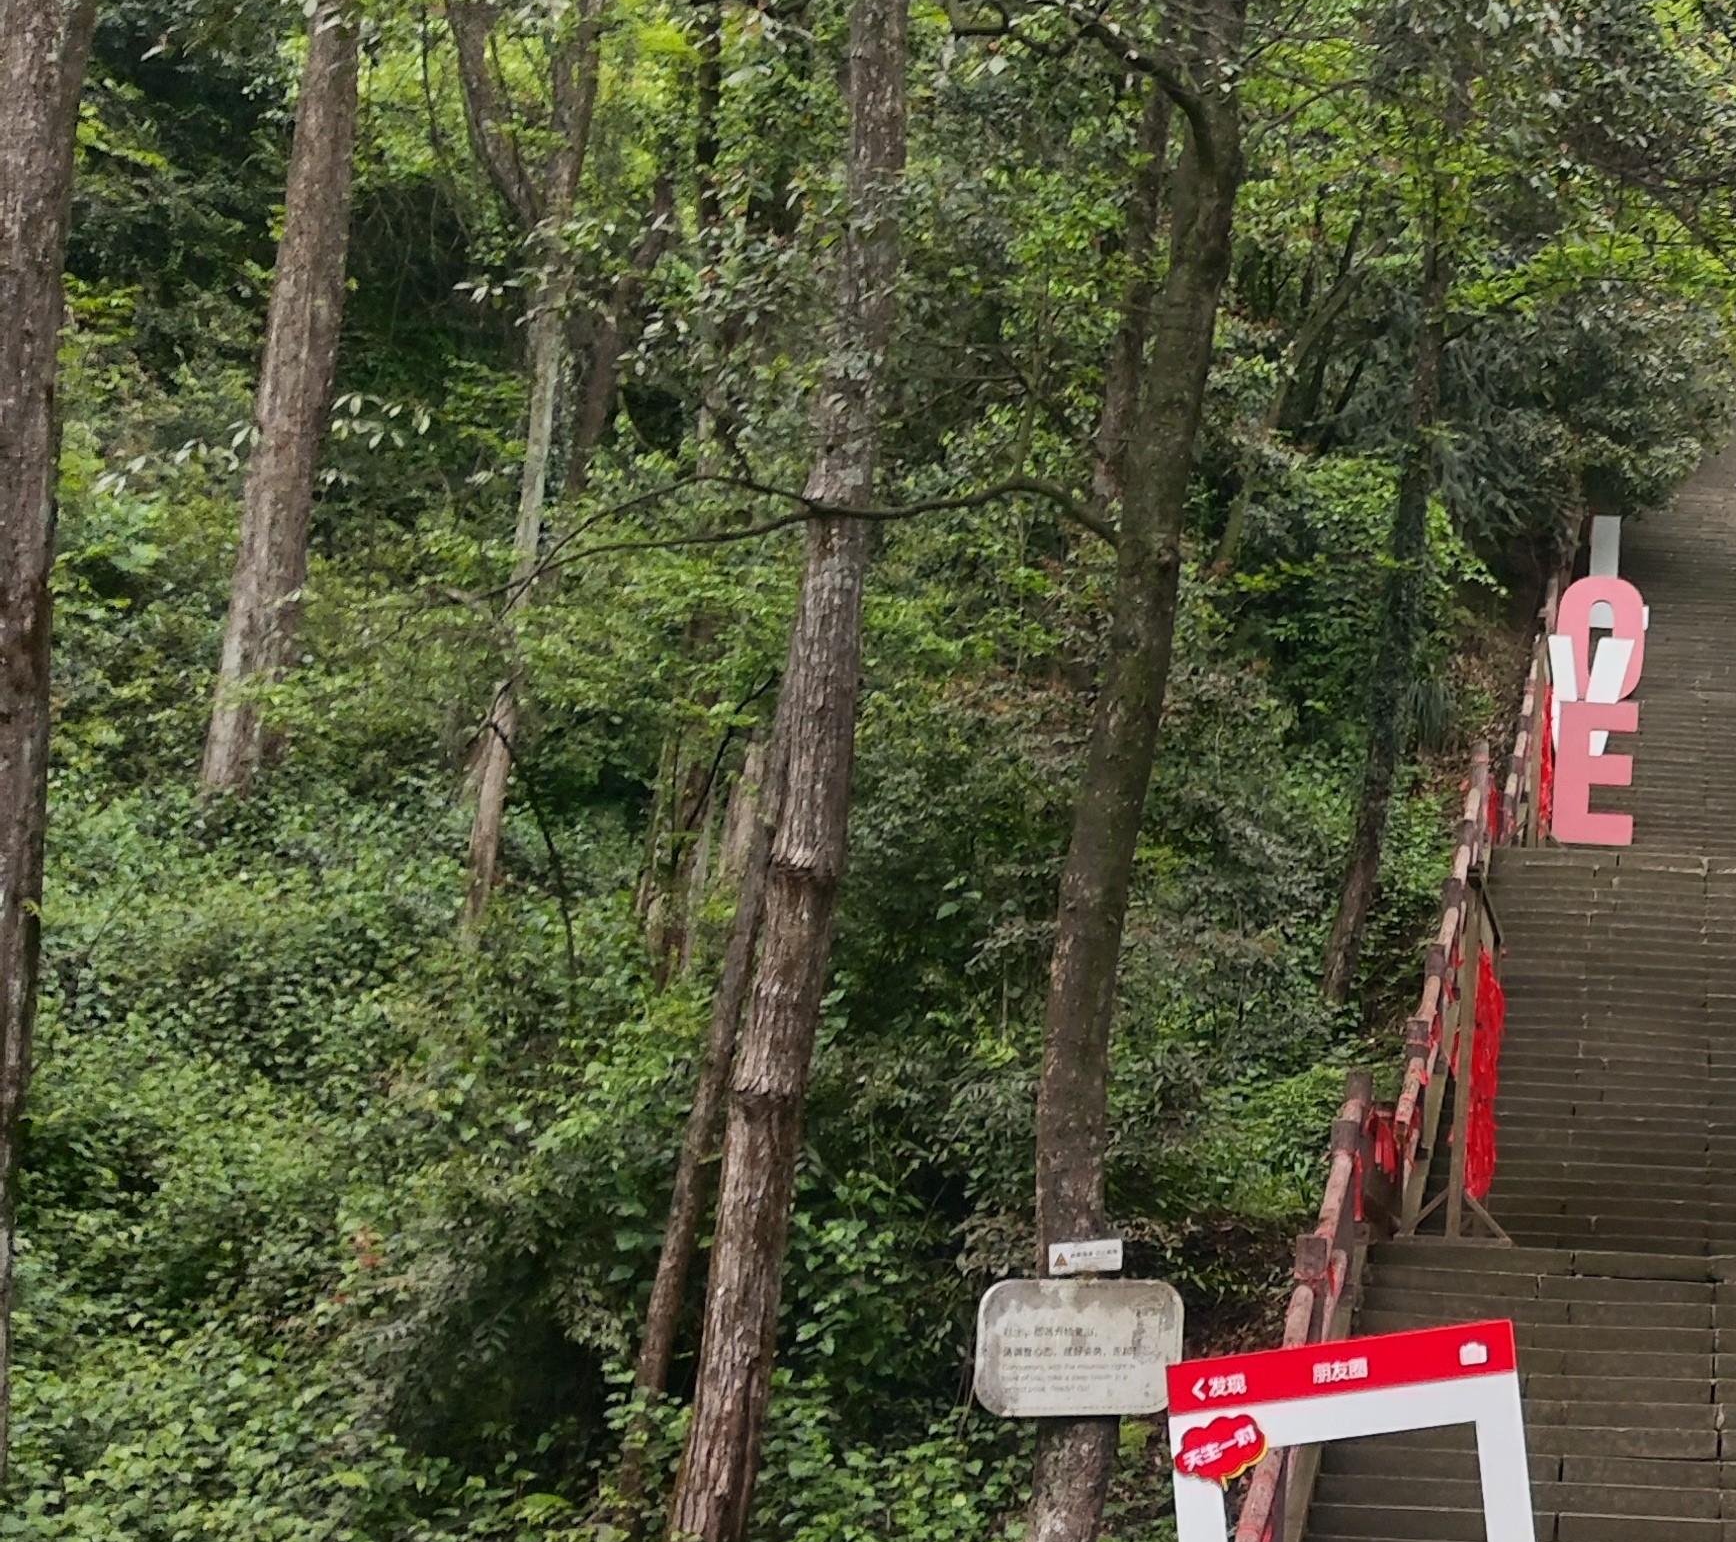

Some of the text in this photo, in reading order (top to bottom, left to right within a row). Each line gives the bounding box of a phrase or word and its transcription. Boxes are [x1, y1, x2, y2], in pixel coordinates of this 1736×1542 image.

[1312, 1357, 1369, 1384] 朋友圈
[1208, 1373, 1247, 1399] 发现
[1182, 1423, 1257, 1472] 天生一对
